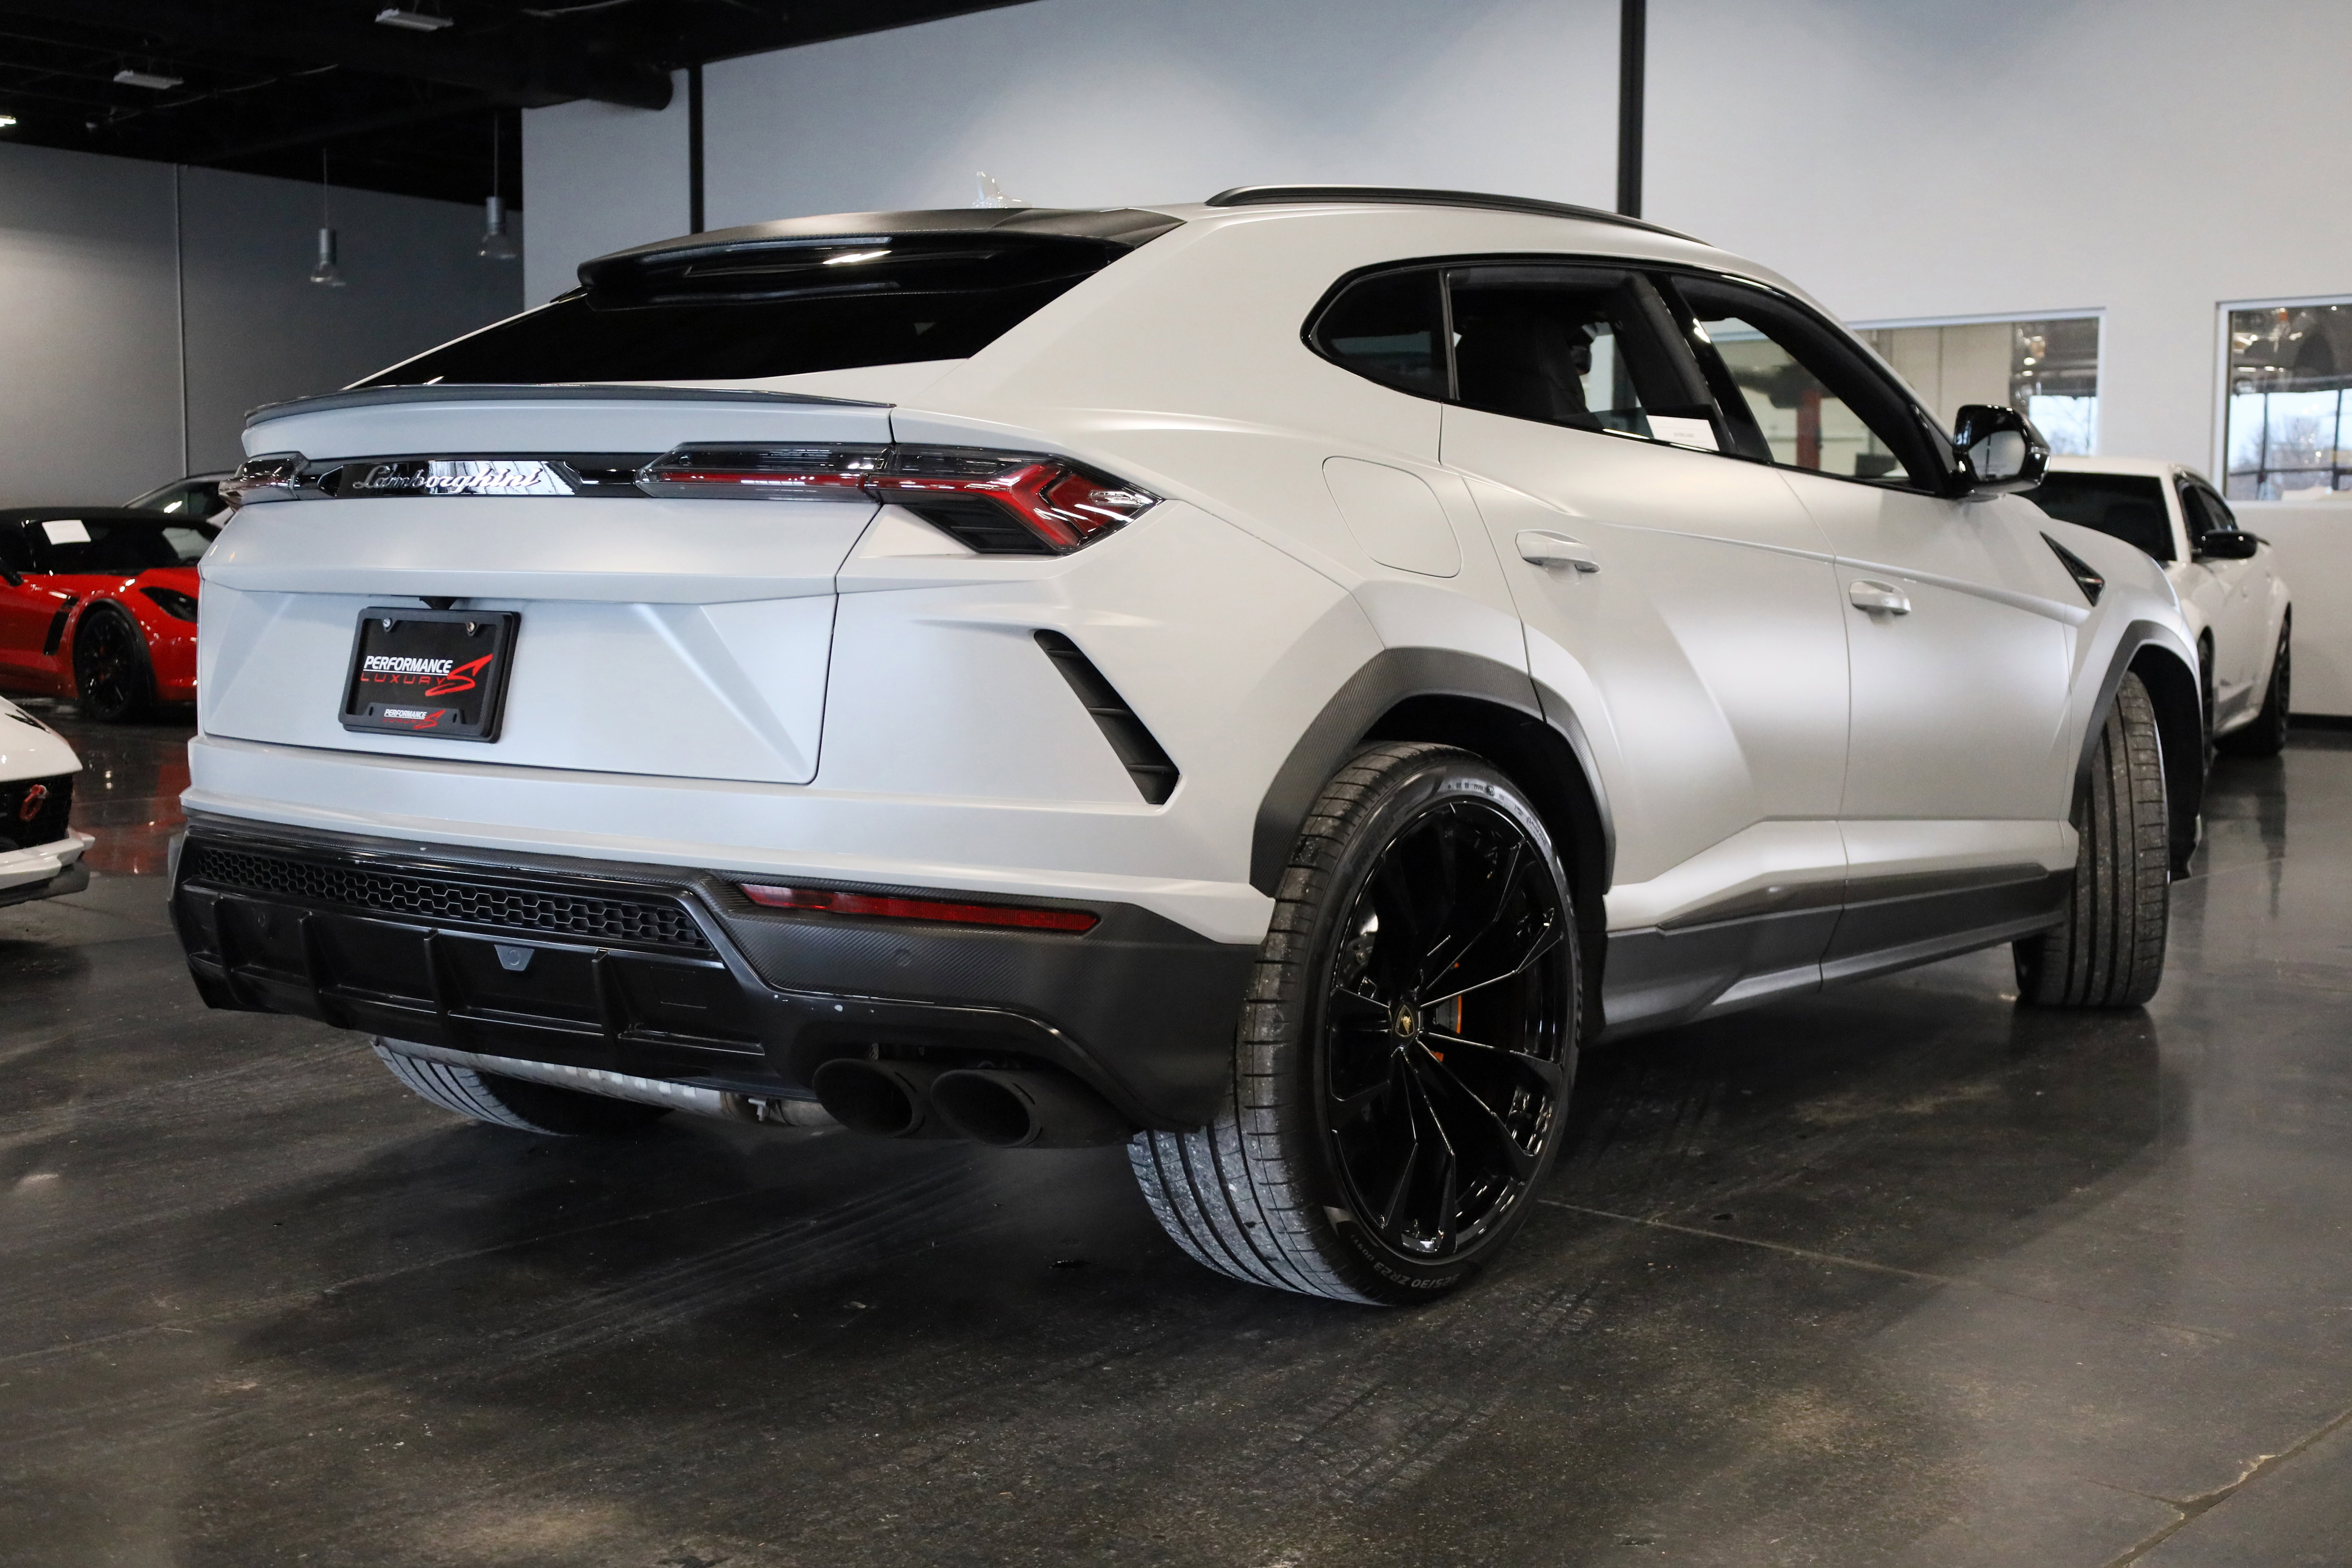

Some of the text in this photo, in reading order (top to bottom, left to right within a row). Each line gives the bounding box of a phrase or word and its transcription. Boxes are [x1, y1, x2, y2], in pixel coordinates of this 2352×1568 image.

[352, 465, 543, 493] Lamborghini
[363, 655, 453, 673] PERFORMANCE
[361, 673, 445, 685] LUXURY
[384, 708, 427, 718] PERFORMANCE
[1373, 1261, 1411, 1285] ZR23
